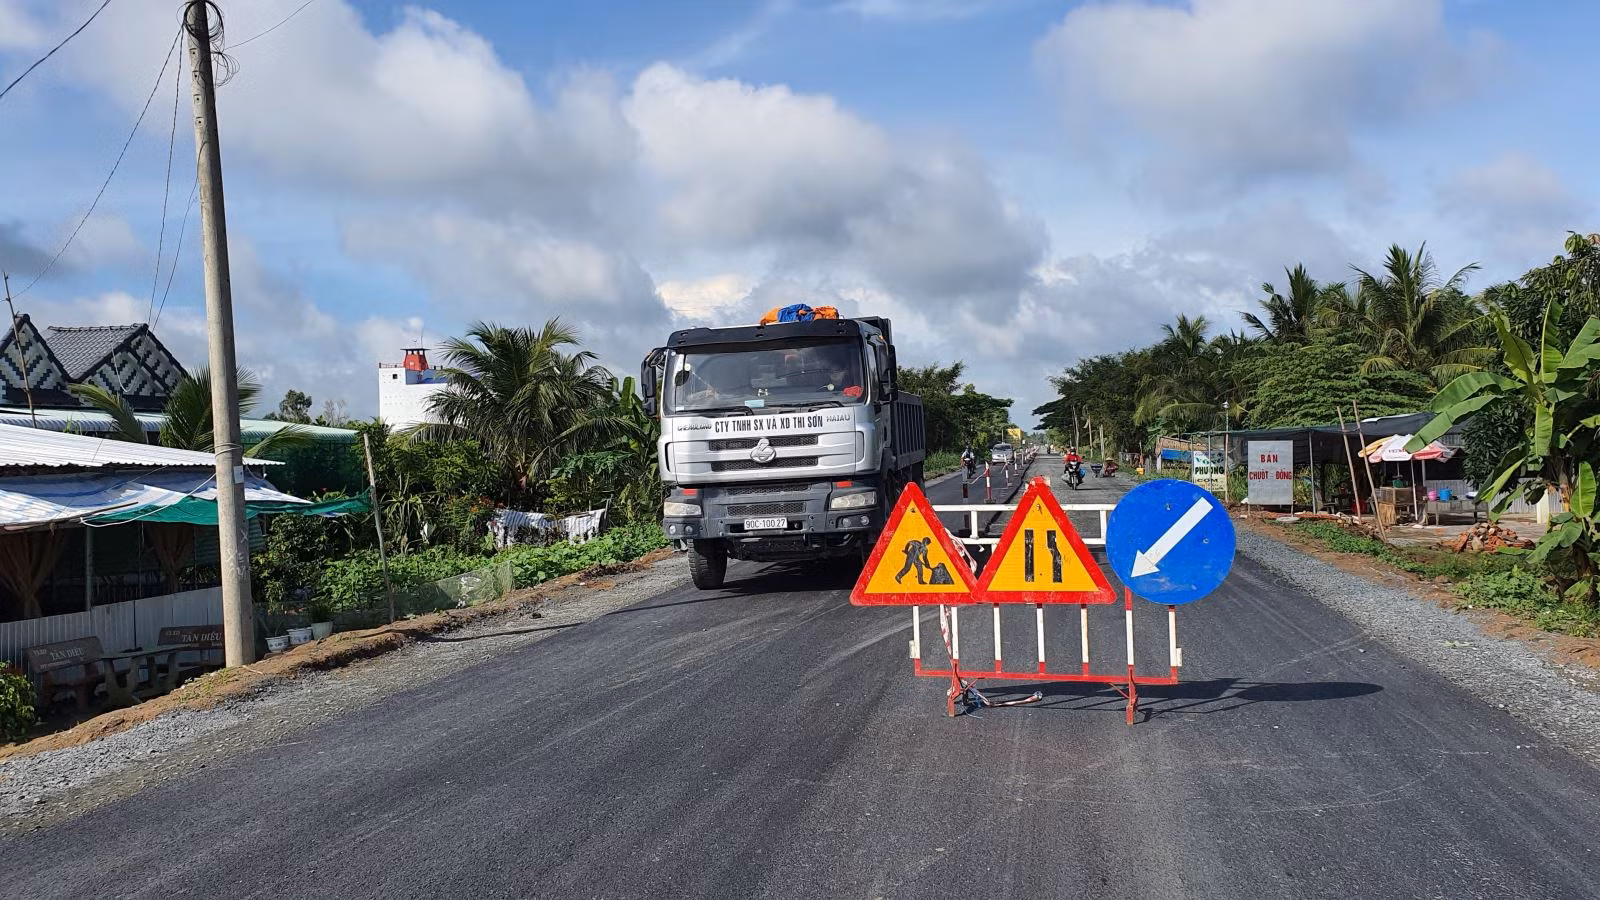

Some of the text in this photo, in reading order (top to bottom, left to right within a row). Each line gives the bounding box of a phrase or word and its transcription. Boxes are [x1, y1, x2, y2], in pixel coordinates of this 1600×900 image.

[715, 421, 729, 433] CTY
[732, 419, 752, 432] TNHH
[754, 419, 764, 431] SX
[793, 416, 805, 429] THI
[807, 414, 823, 428] SƠN
